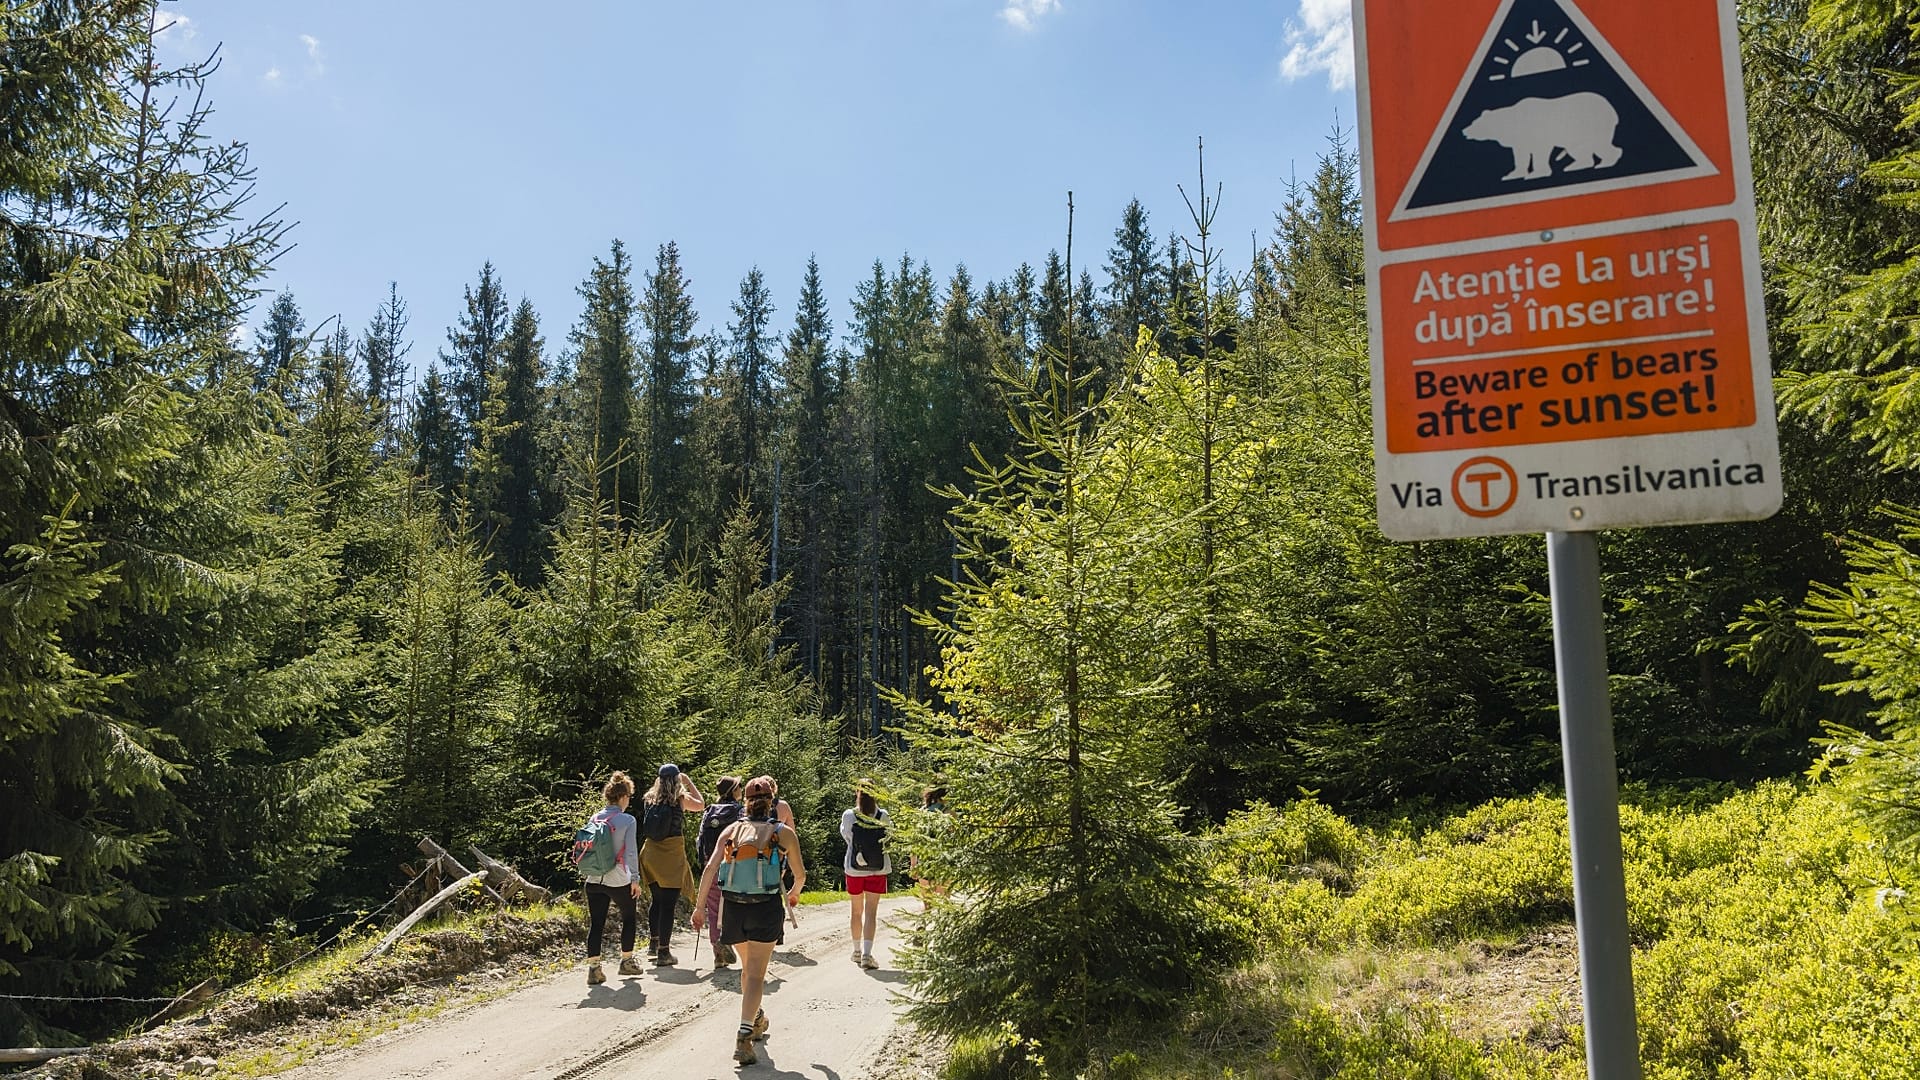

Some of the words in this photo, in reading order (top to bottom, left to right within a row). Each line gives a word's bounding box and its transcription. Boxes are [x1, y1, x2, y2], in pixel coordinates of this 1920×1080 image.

[1413, 257, 1560, 304] Atenție
[1576, 251, 1614, 285] la
[1630, 235, 1710, 283] urși
[1414, 302, 1512, 346] după
[1525, 279, 1716, 332] înserare!
[1415, 365, 1548, 400] Beware
[1562, 353, 1599, 385] of
[1611, 347, 1718, 380] bears
[1416, 399, 1523, 438] after
[1540, 374, 1718, 428] sunset!
[1391, 481, 1443, 508] Via
[1527, 459, 1765, 500] Transilvanica
